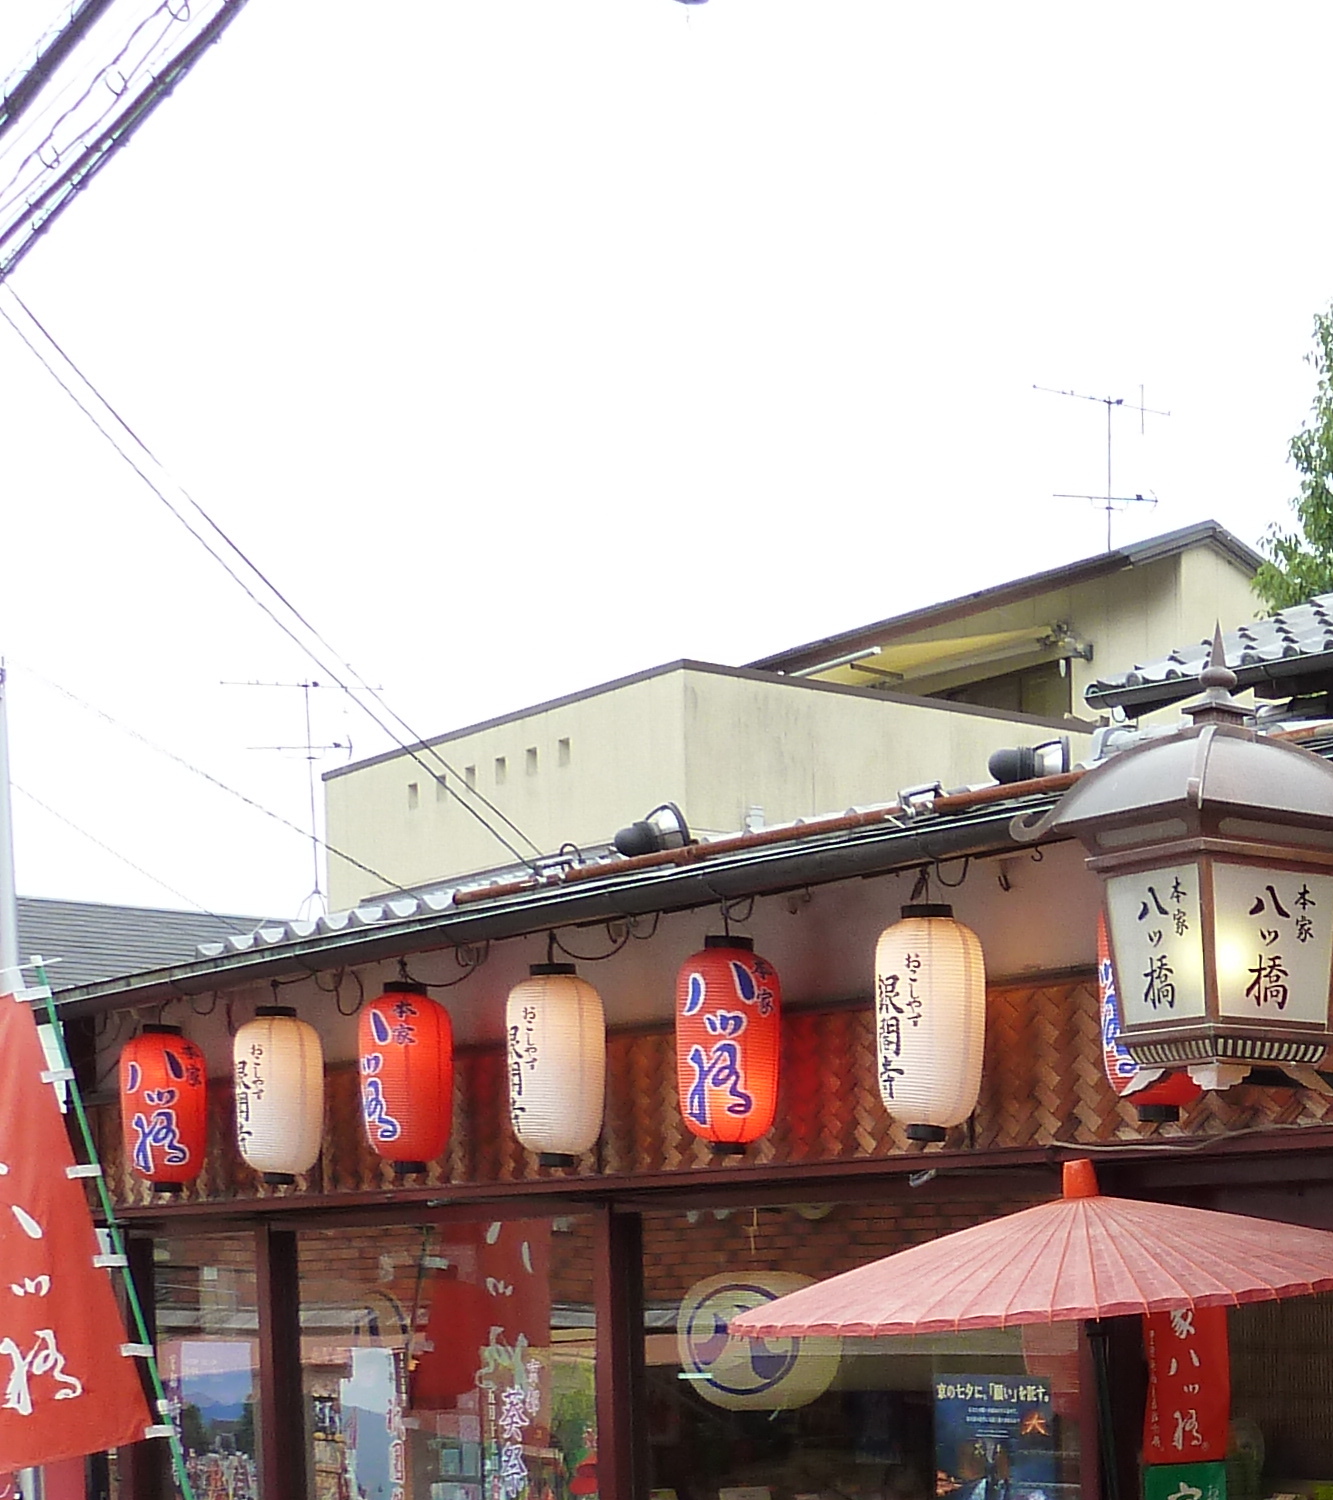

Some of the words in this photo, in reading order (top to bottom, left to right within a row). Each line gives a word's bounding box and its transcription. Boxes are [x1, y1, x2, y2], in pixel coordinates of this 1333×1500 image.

[1169, 876, 1190, 937] 本家
[1295, 884, 1316, 943] 本家
[1138, 886, 1177, 1010] 八ツ橋
[1245, 885, 1291, 1010] 八ツ橋
[392, 1001, 417, 1044] 本家
